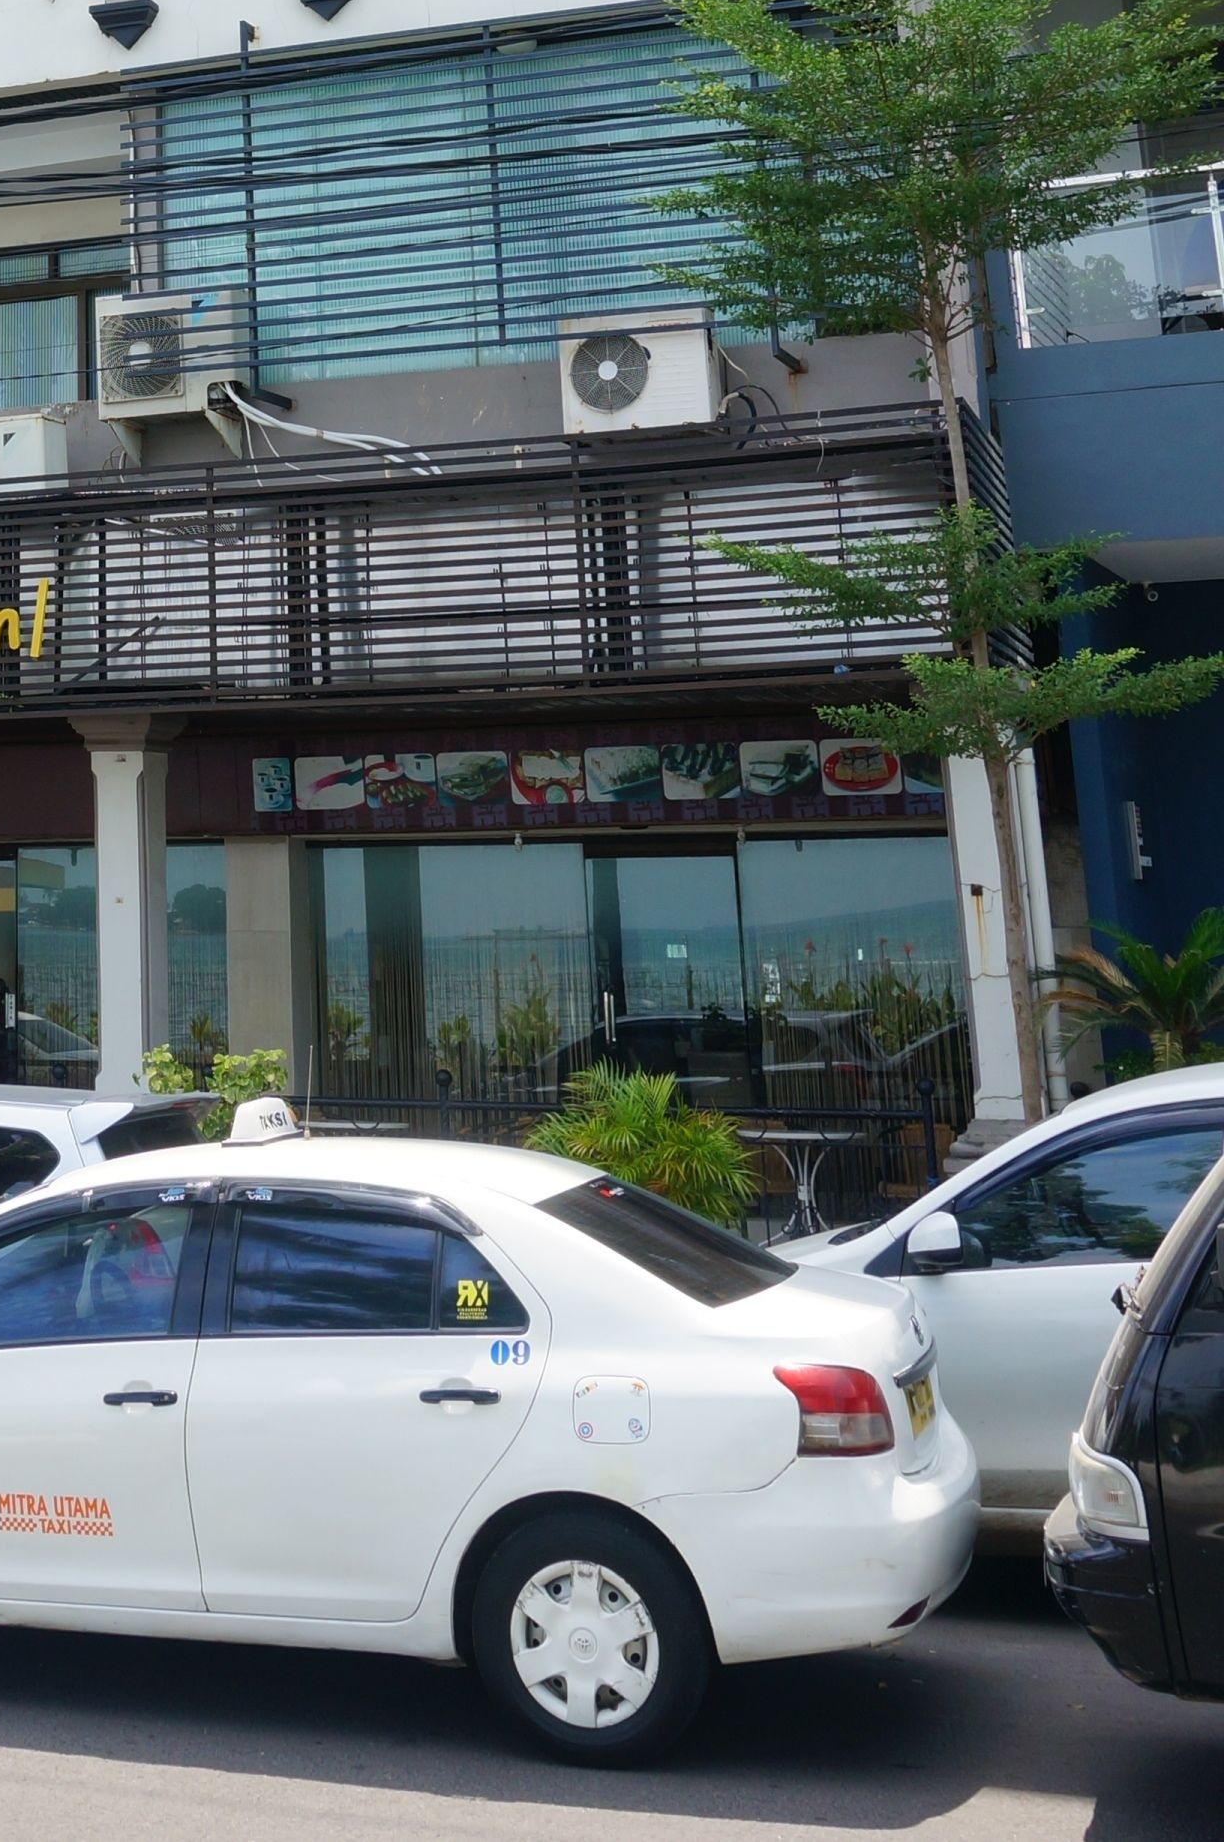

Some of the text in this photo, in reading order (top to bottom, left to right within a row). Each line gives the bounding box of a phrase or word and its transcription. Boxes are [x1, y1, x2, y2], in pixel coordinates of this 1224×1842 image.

[259, 1111, 288, 1131] TAKSI
[490, 1339, 531, 1366] 09
[53, 1495, 112, 1519] UTAMA
[38, 1518, 72, 1535] TAXI
